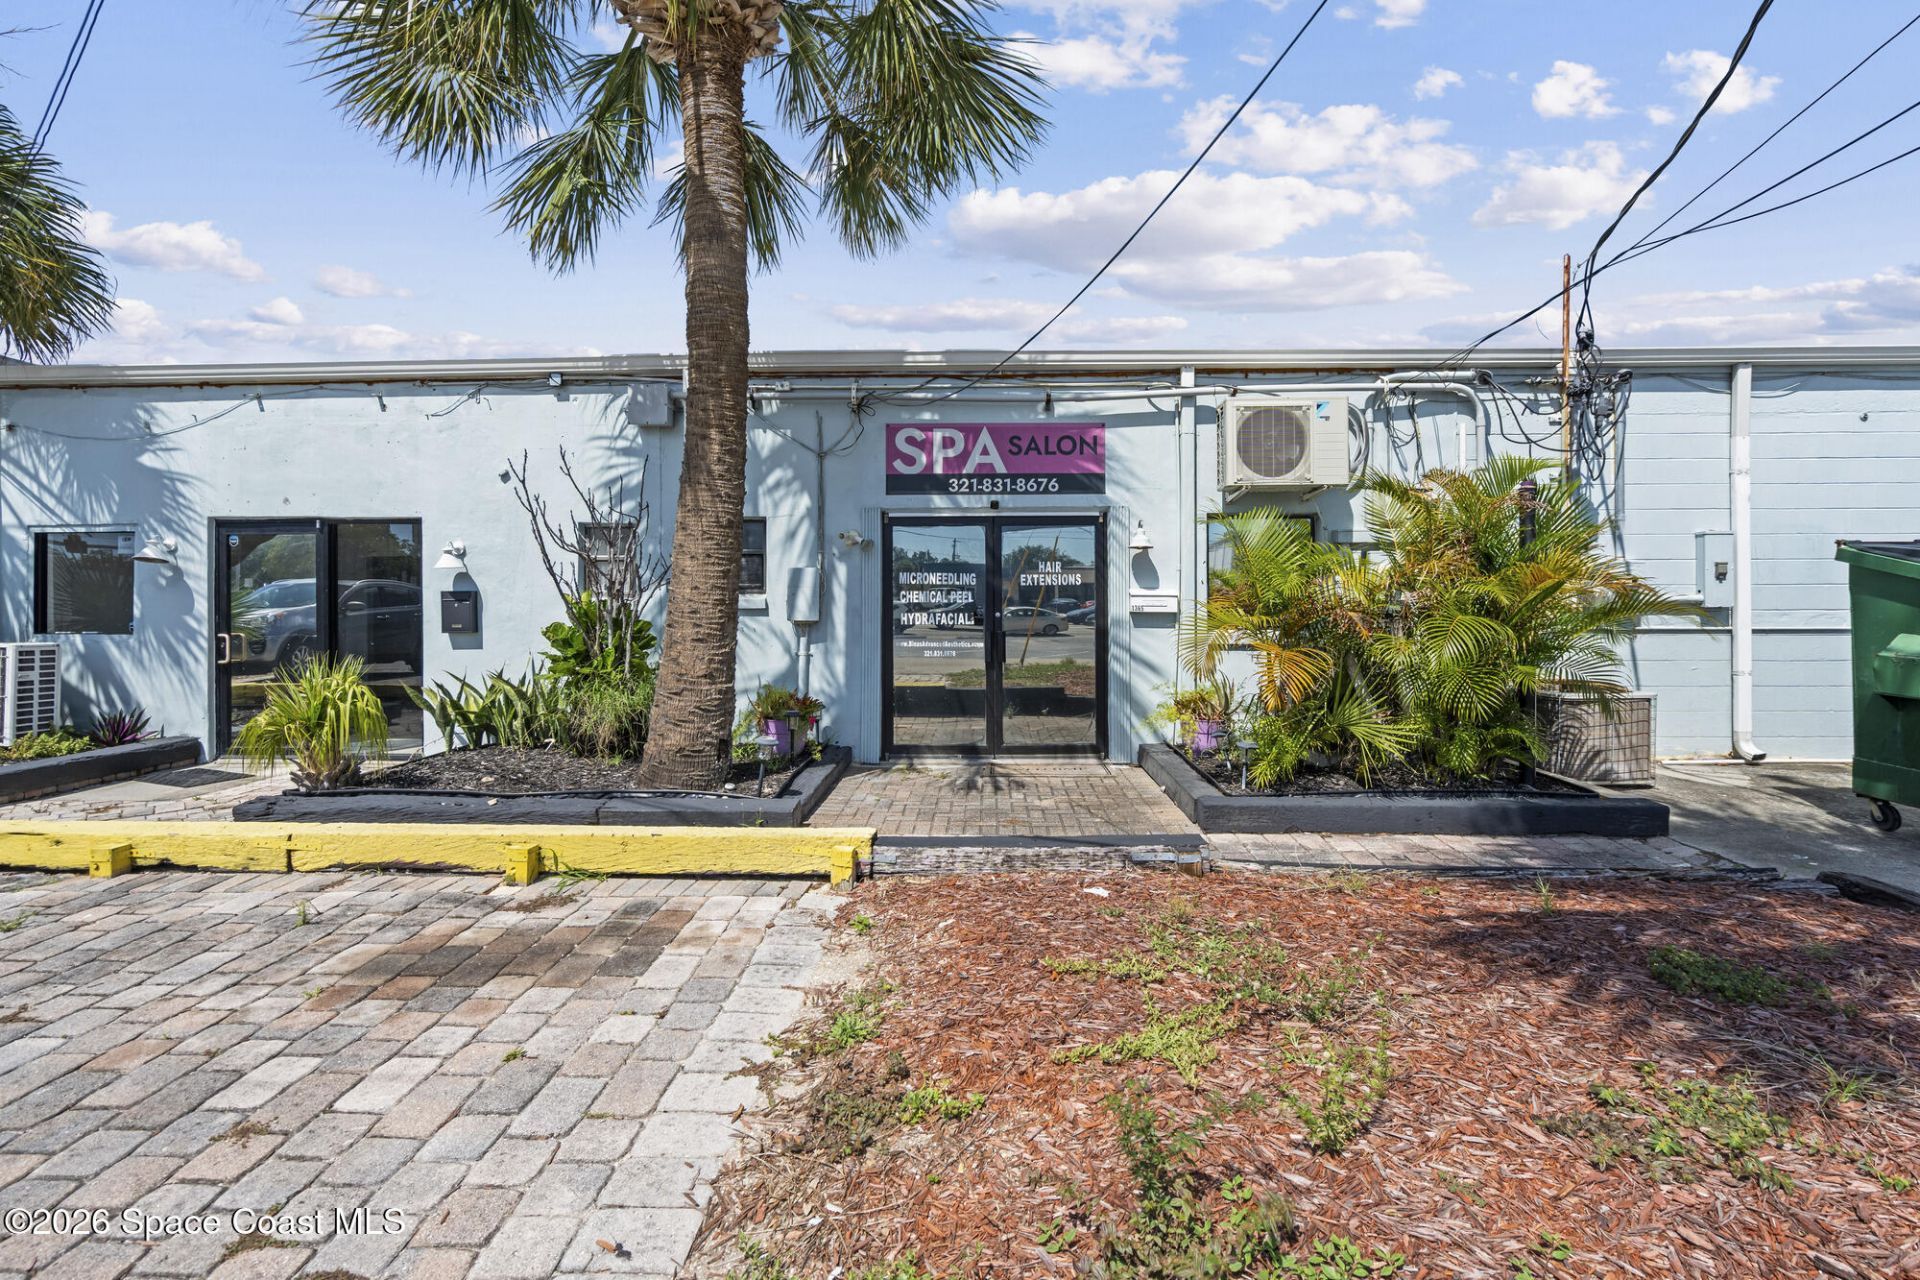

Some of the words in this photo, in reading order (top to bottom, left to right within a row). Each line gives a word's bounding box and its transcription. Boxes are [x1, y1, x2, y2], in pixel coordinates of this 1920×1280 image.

[892, 426, 1008, 474] SPA
[1008, 435, 1098, 456] SALON
[948, 478, 1059, 493] 321-831-8676
[1038, 561, 1062, 573] HAIR
[898, 572, 977, 585] MICRONEEDLING
[1020, 574, 1082, 586] EXTENSIONS
[900, 590, 948, 603] CHEMICAL
[950, 591, 974, 603] PEEL
